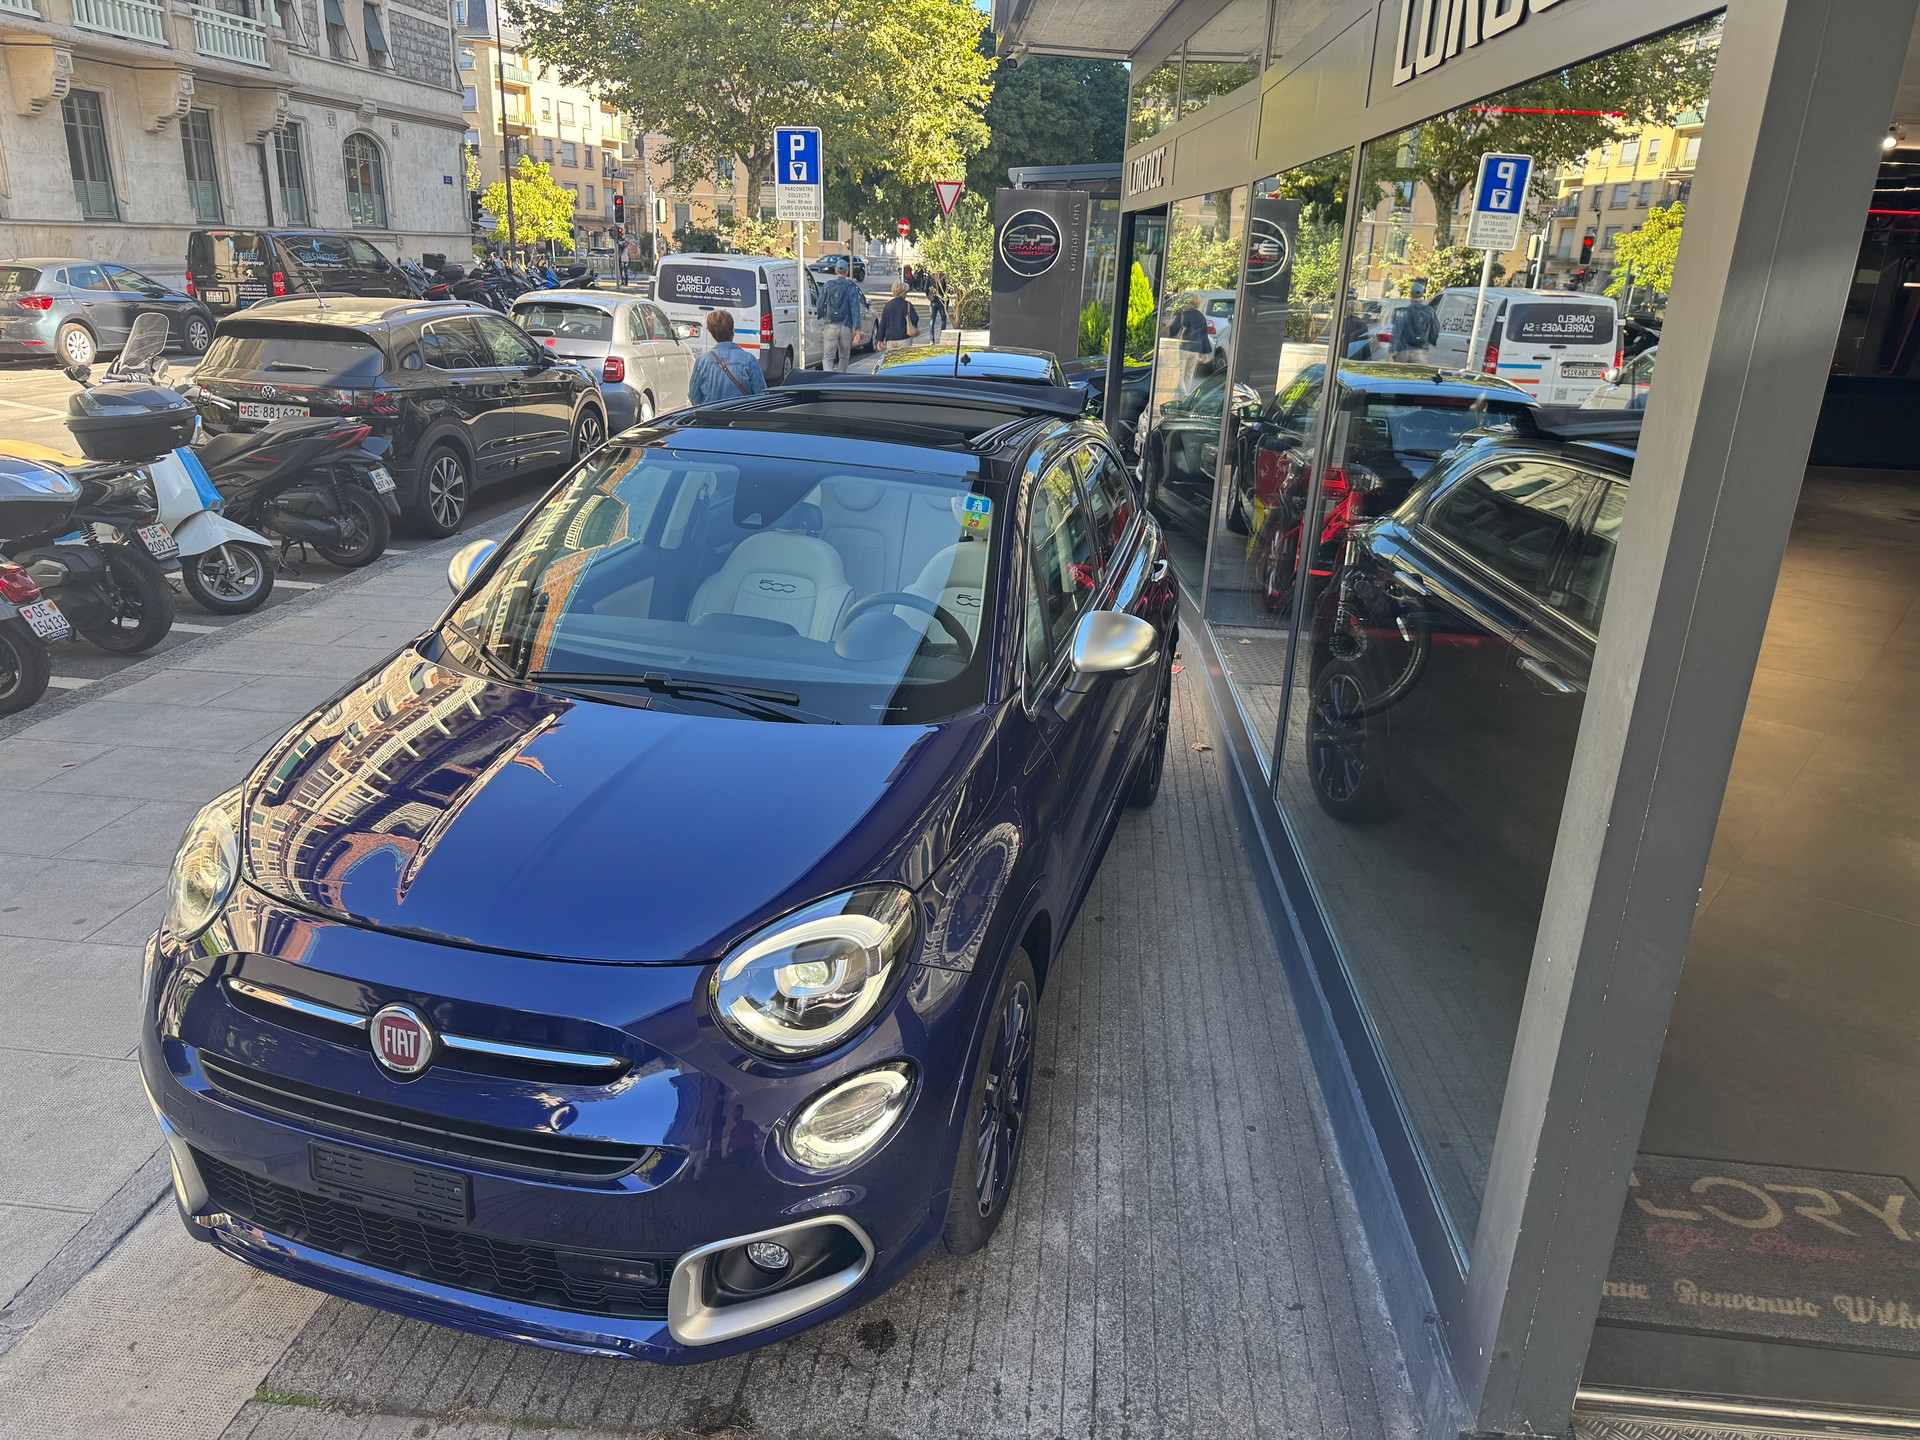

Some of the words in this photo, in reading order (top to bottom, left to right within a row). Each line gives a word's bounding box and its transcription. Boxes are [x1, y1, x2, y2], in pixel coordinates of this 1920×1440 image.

[790, 134, 805, 160] P
[1008, 234, 1057, 247] BYD
[676, 274, 711, 285] CARMELO
[676, 283, 725, 295] CARRELAGES
[730, 287, 742, 297] SA
[149, 526, 161, 539] GE
[149, 536, 176, 552] 20912
[758, 579, 797, 593] 500
[32, 603, 50, 617] GE
[33, 615, 68, 635] 154133
[383, 1025, 418, 1058] FIAT
[1673, 1278, 1820, 1317] Benvenuto
